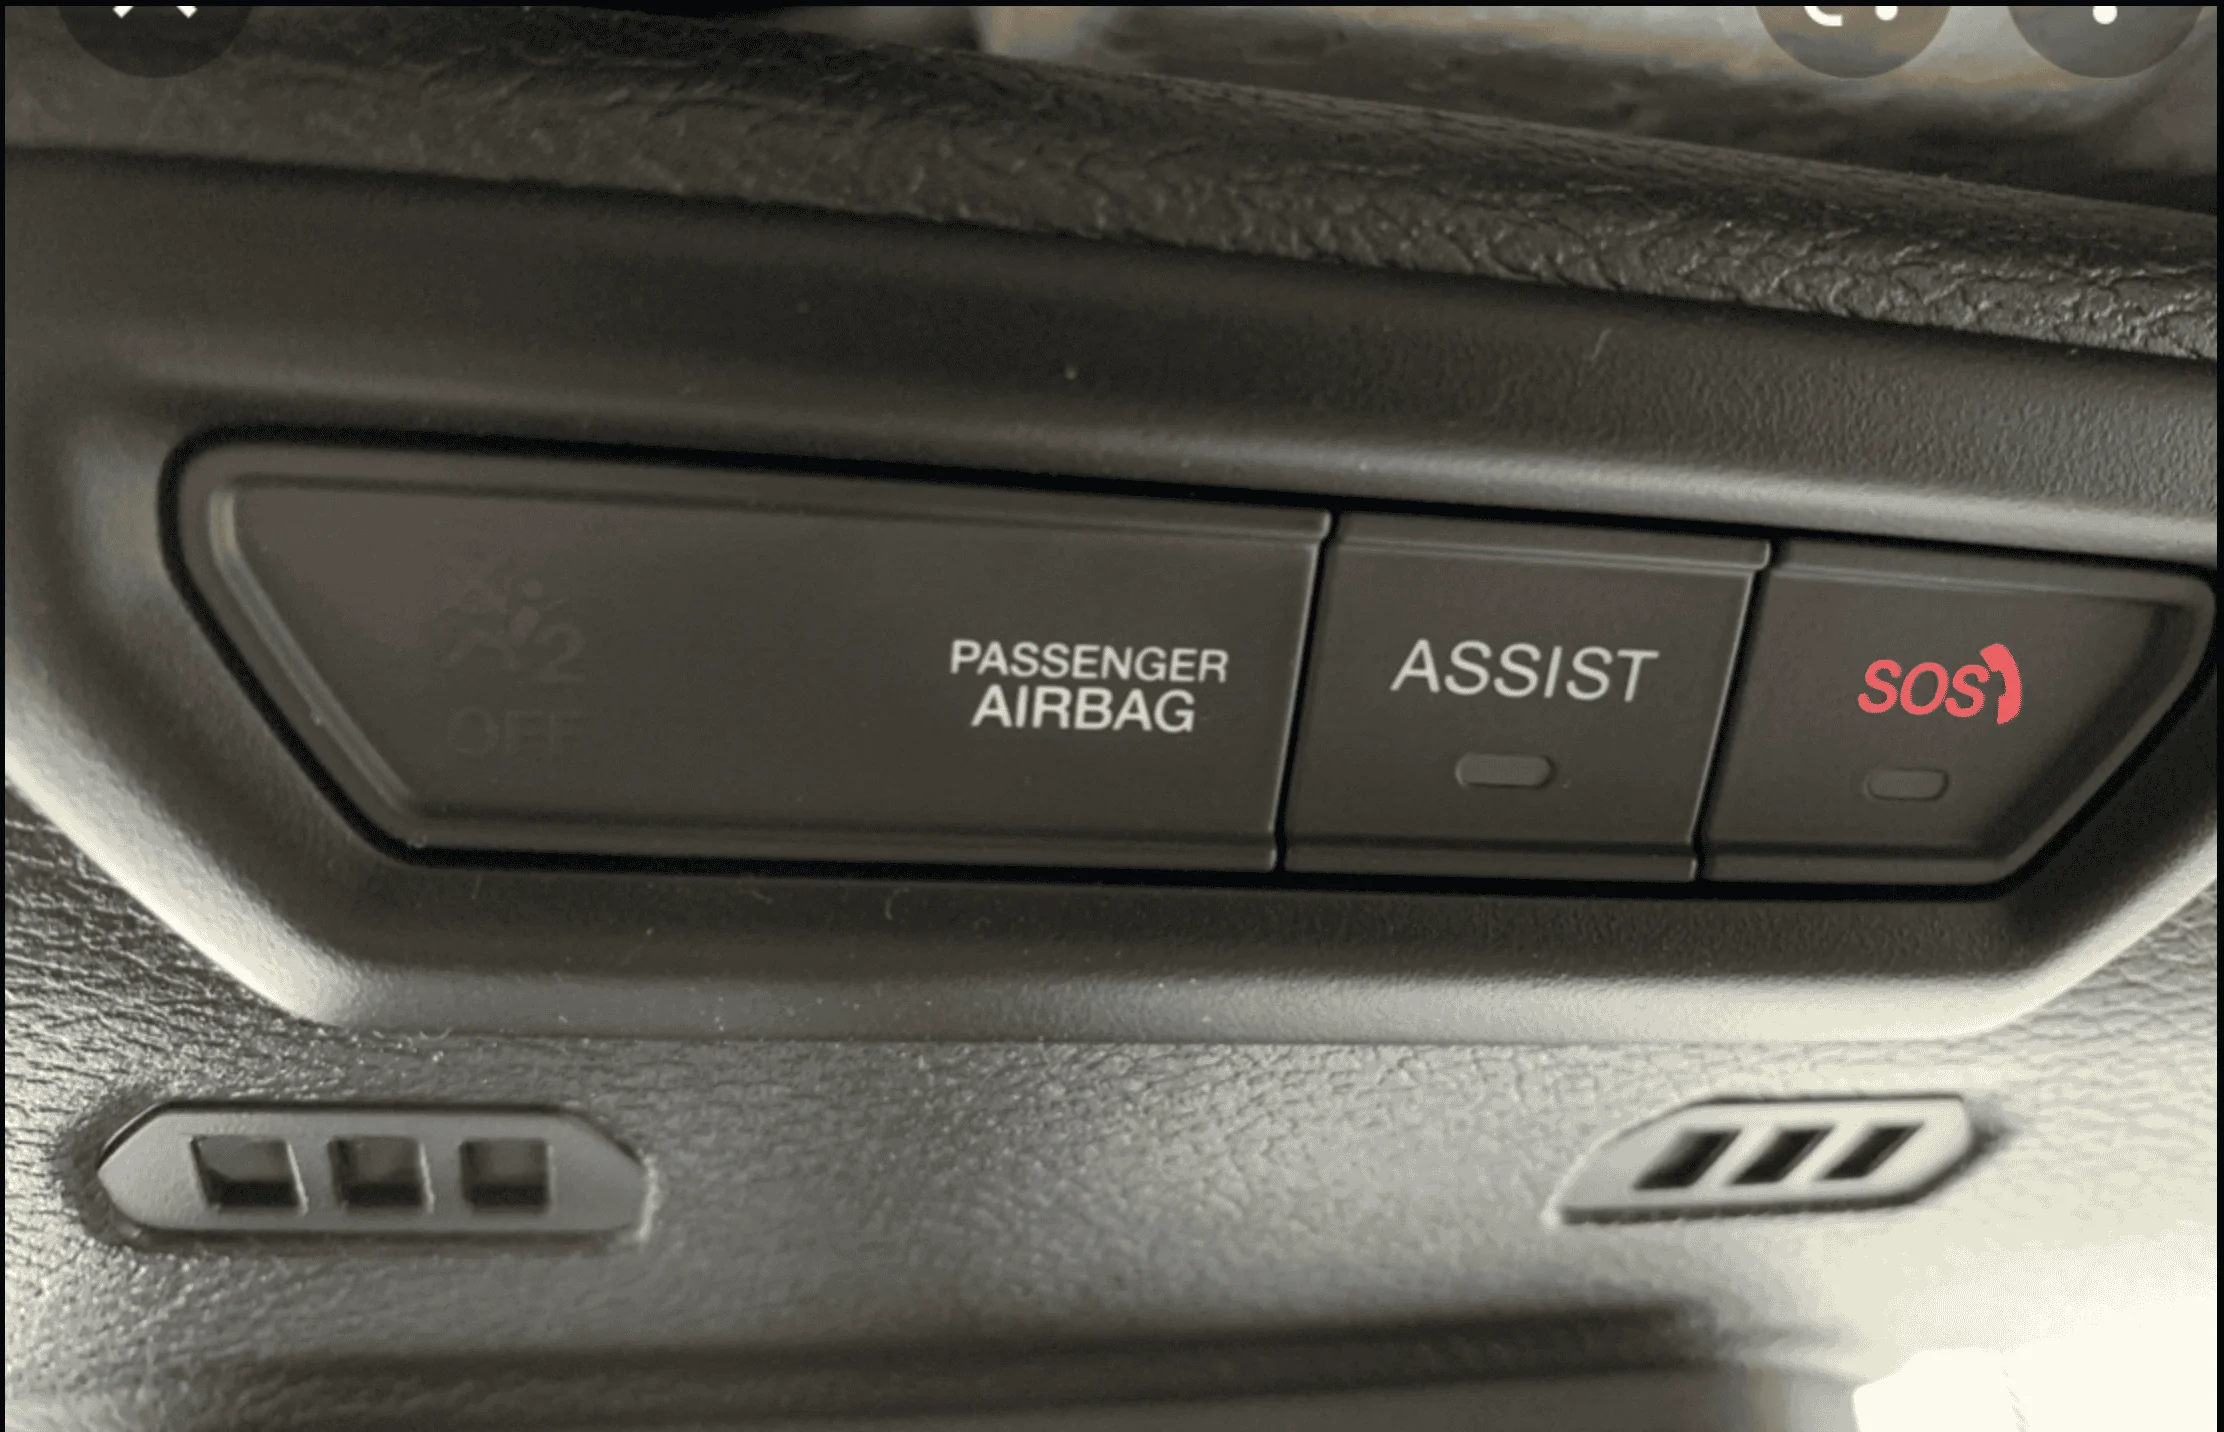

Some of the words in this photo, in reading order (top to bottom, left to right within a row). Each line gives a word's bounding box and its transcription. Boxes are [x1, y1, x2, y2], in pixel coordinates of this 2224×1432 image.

[950, 638, 1229, 683] PASSENGER
[1390, 638, 1659, 701] ASSIST
[970, 683, 1197, 733] AIRBAG
[1857, 659, 1990, 718] SOS
[446, 705, 586, 756] OFF
